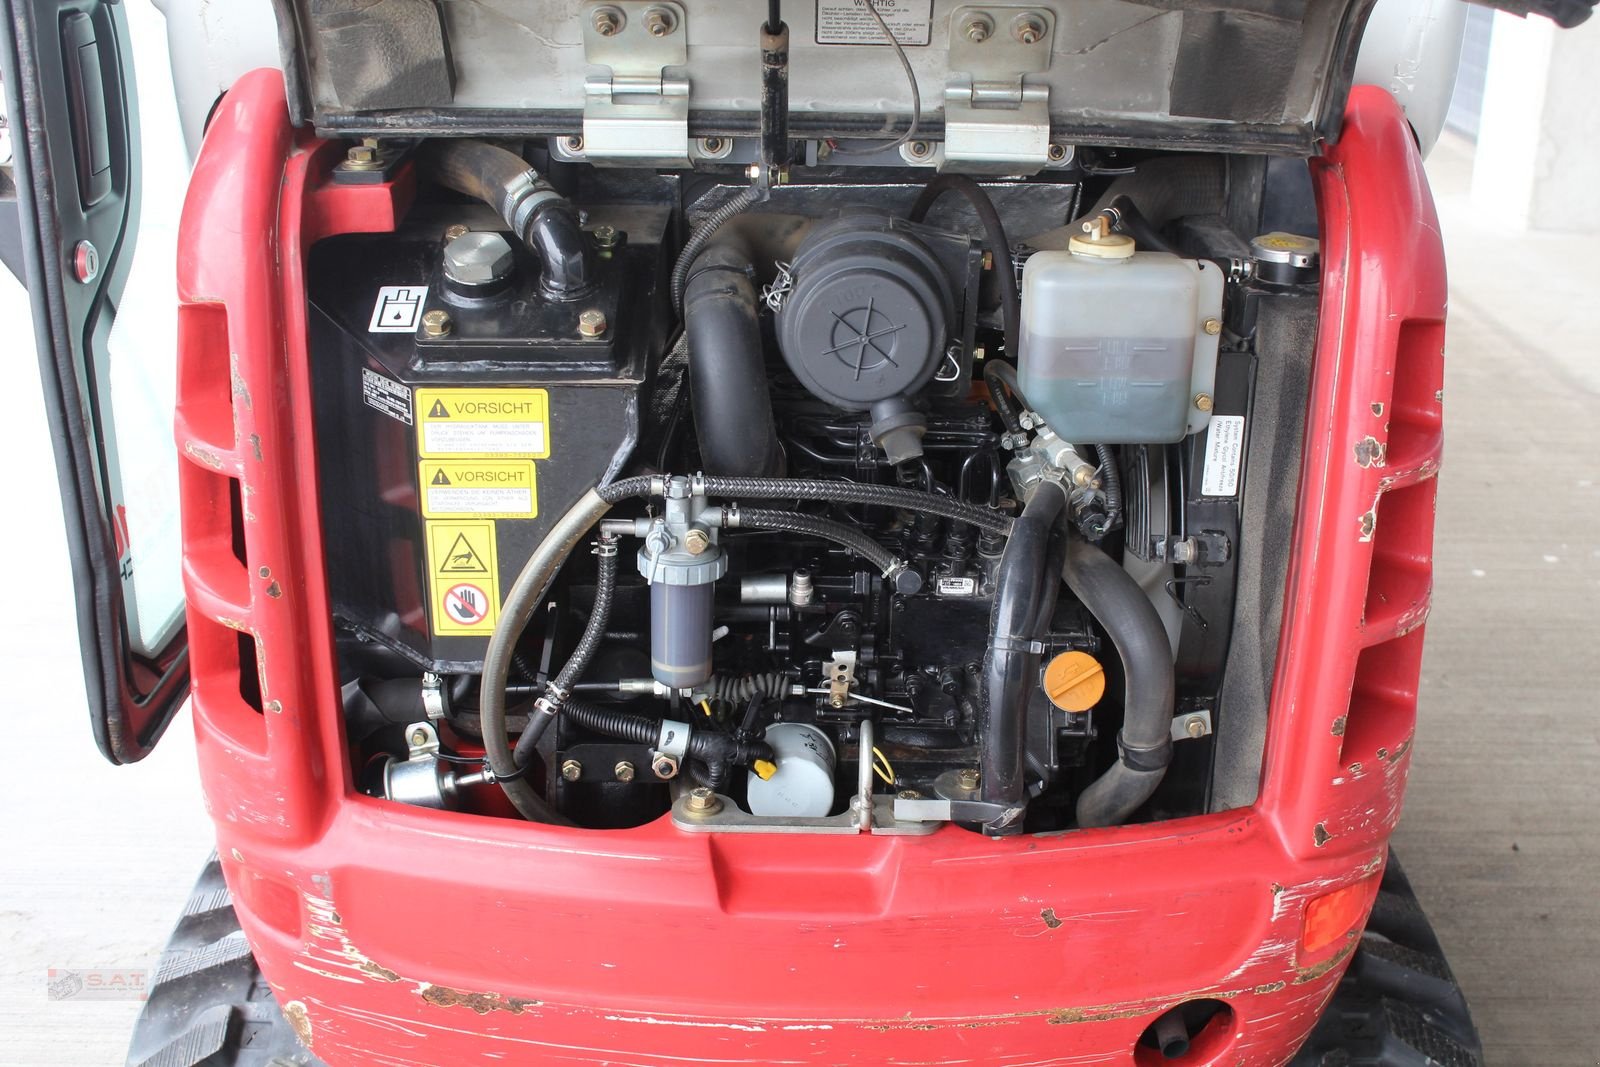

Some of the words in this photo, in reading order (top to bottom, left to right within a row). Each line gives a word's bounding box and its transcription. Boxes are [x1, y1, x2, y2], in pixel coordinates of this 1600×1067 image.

[454, 402, 532, 414] VORSICHT
[1224, 420, 1232, 444] Ethylene
[1221, 446, 1229, 462] Glycol
[1230, 444, 1238, 466] Contains
[455, 471, 525, 482] VORSICHT
[1218, 465, 1226, 492] Antifreeze
